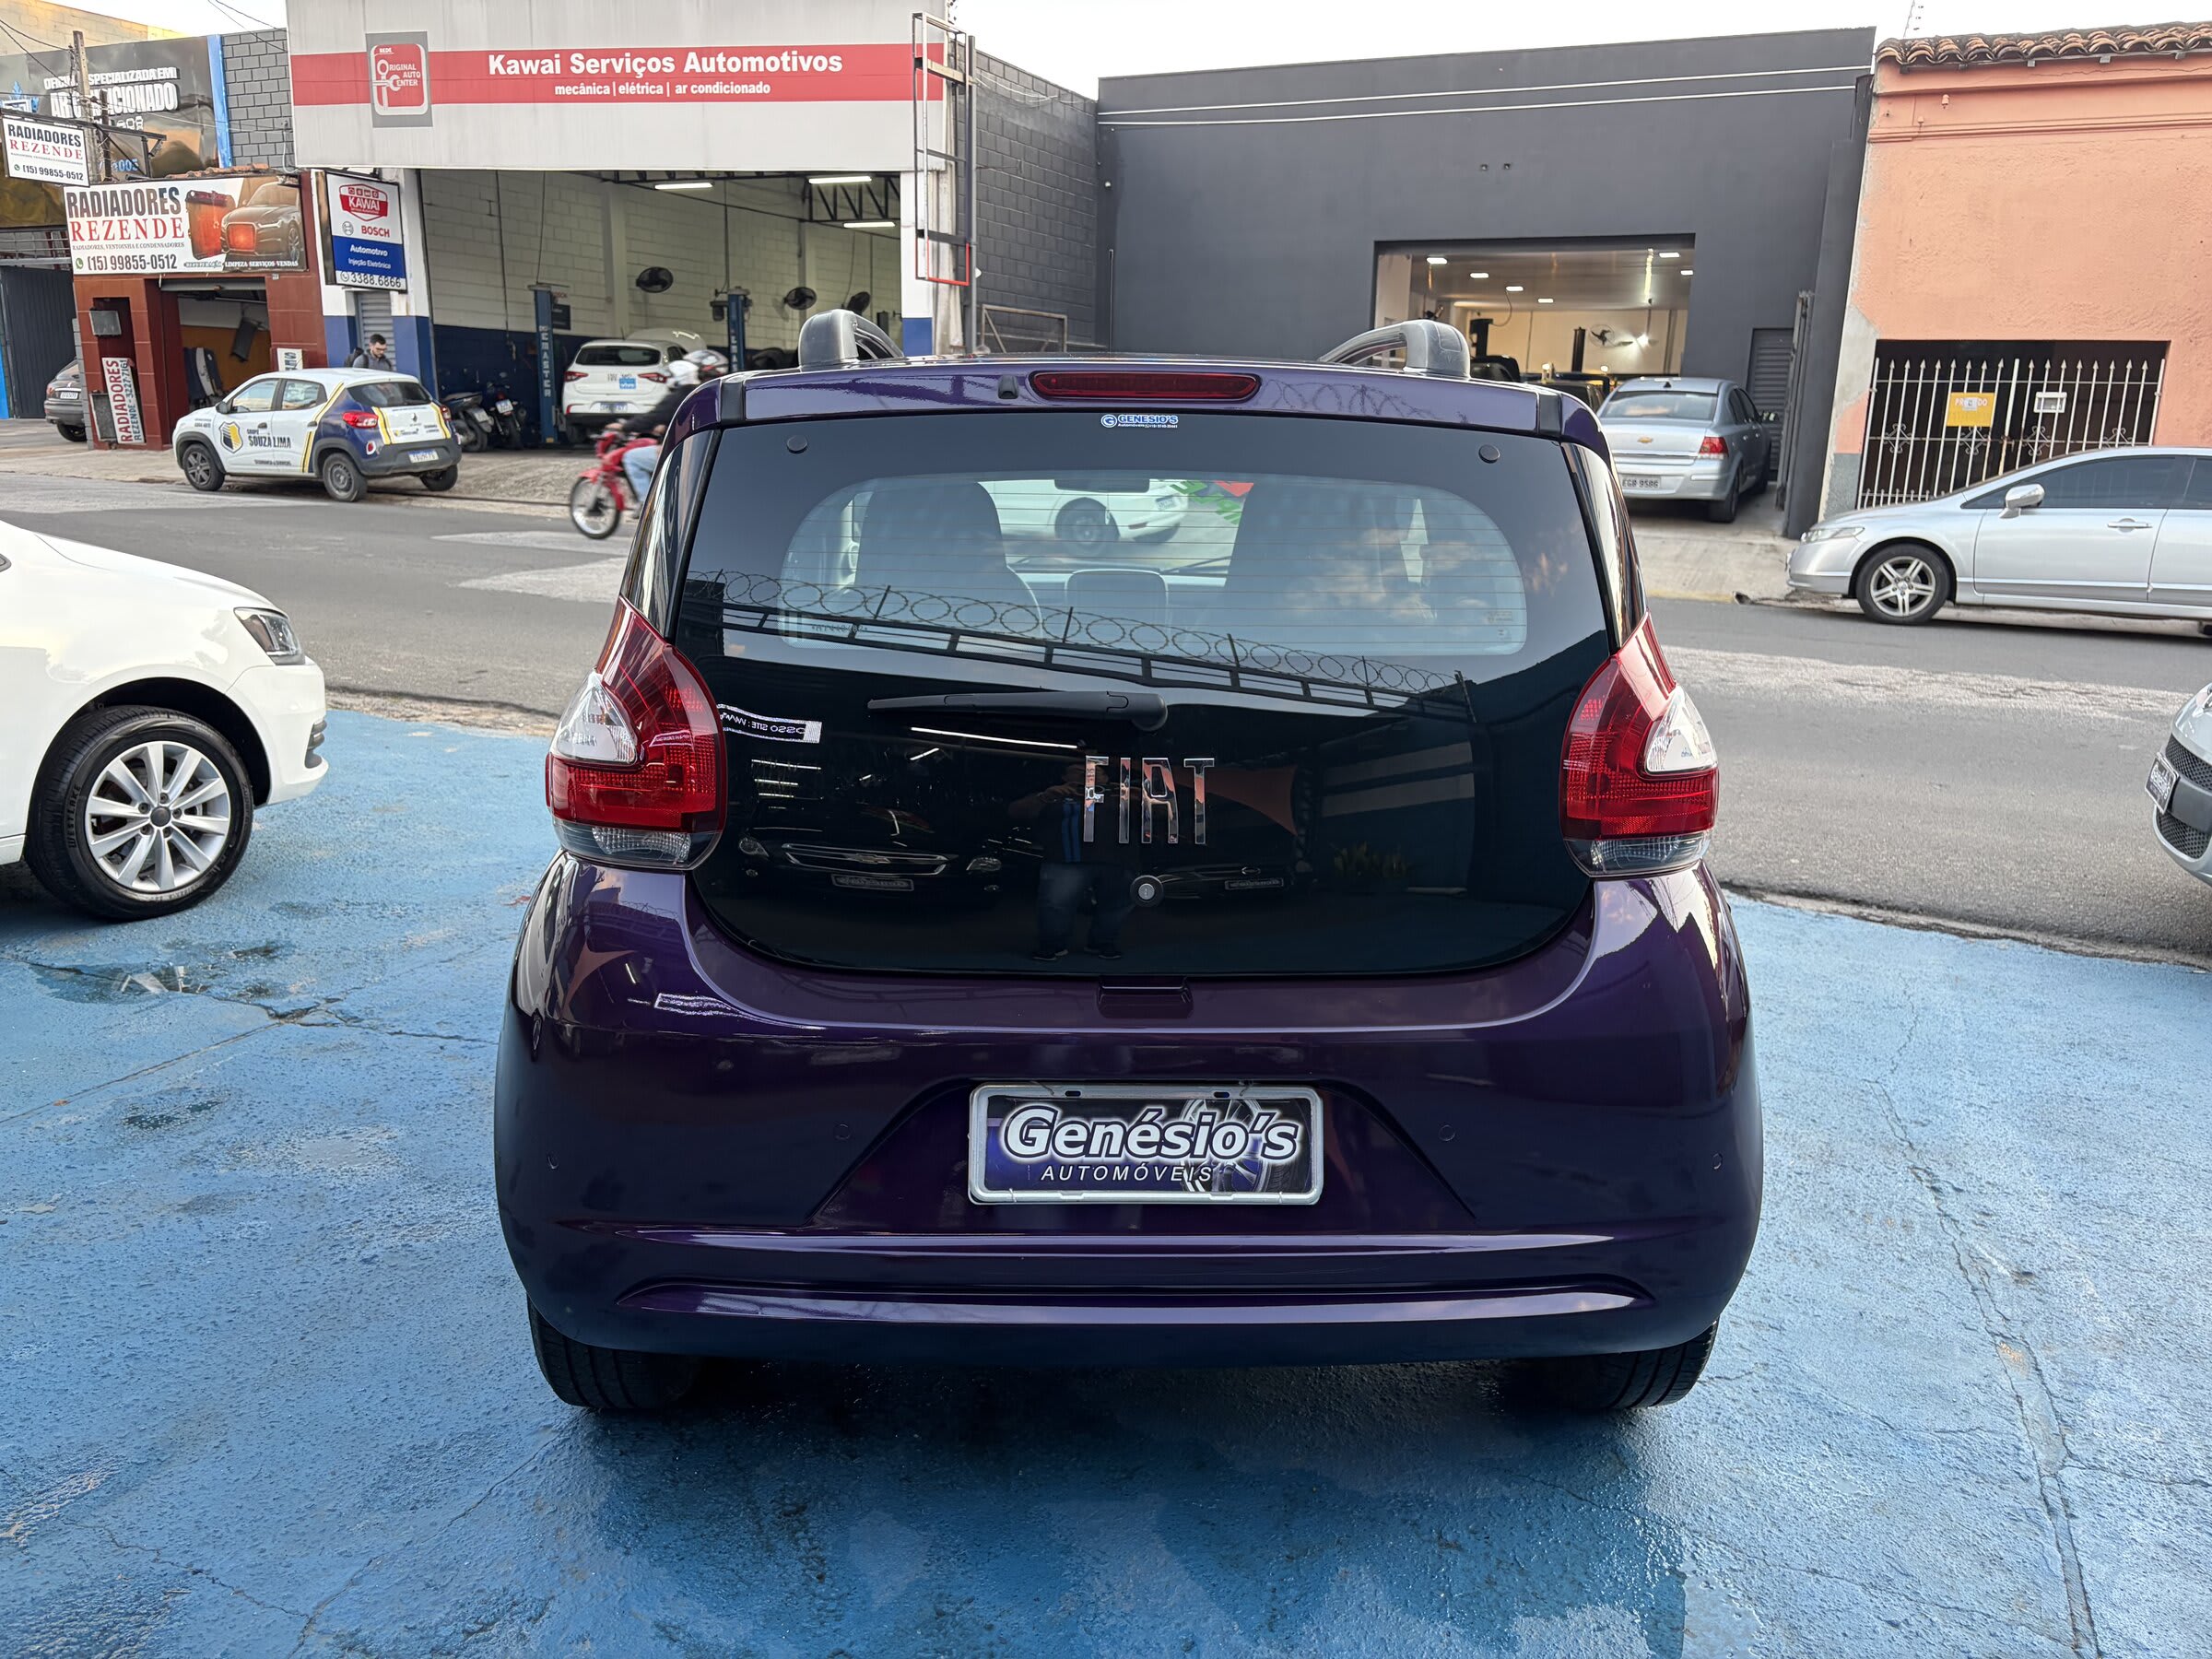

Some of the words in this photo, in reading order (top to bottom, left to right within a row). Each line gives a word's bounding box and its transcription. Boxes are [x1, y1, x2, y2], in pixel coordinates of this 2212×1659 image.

[488, 53, 561, 76] Kawai
[570, 52, 676, 78] Serviços
[684, 50, 843, 74] Automotivos
[88, 69, 157, 85] SPECIALIZADA
[555, 81, 610, 96] mecânica
[618, 81, 664, 96] elétrica
[675, 84, 688, 94] ar
[690, 80, 771, 94] condicionado
[8, 124, 81, 147] RADIADORES
[10, 139, 83, 160] REZENDE
[22, 165, 38, 174] (15)
[39, 167, 84, 181] 99855-0512
[66, 187, 182, 218] RADIADORES
[348, 196, 380, 211] KAWAI
[70, 218, 184, 241] REZENDE
[361, 225, 391, 238] BOSCH
[349, 244, 388, 256] Automotivo
[87, 255, 108, 270] (15)
[110, 253, 178, 270] 99855-0512
[351, 273, 401, 288] 3388.6866
[106, 360, 134, 441] RADIADORES
[129, 405, 142, 441] REZENDE
[1117, 415, 1179, 424] GENESIO'S
[248, 435, 272, 447] SOUZA
[273, 436, 291, 449] LIMA
[1084, 755, 1215, 844] FIAT
[66, 785, 81, 848] WESTLAKE
[1004, 1104, 1300, 1159] Genésio's
[1041, 1161, 1214, 1182] AUTOMÓVEIS
